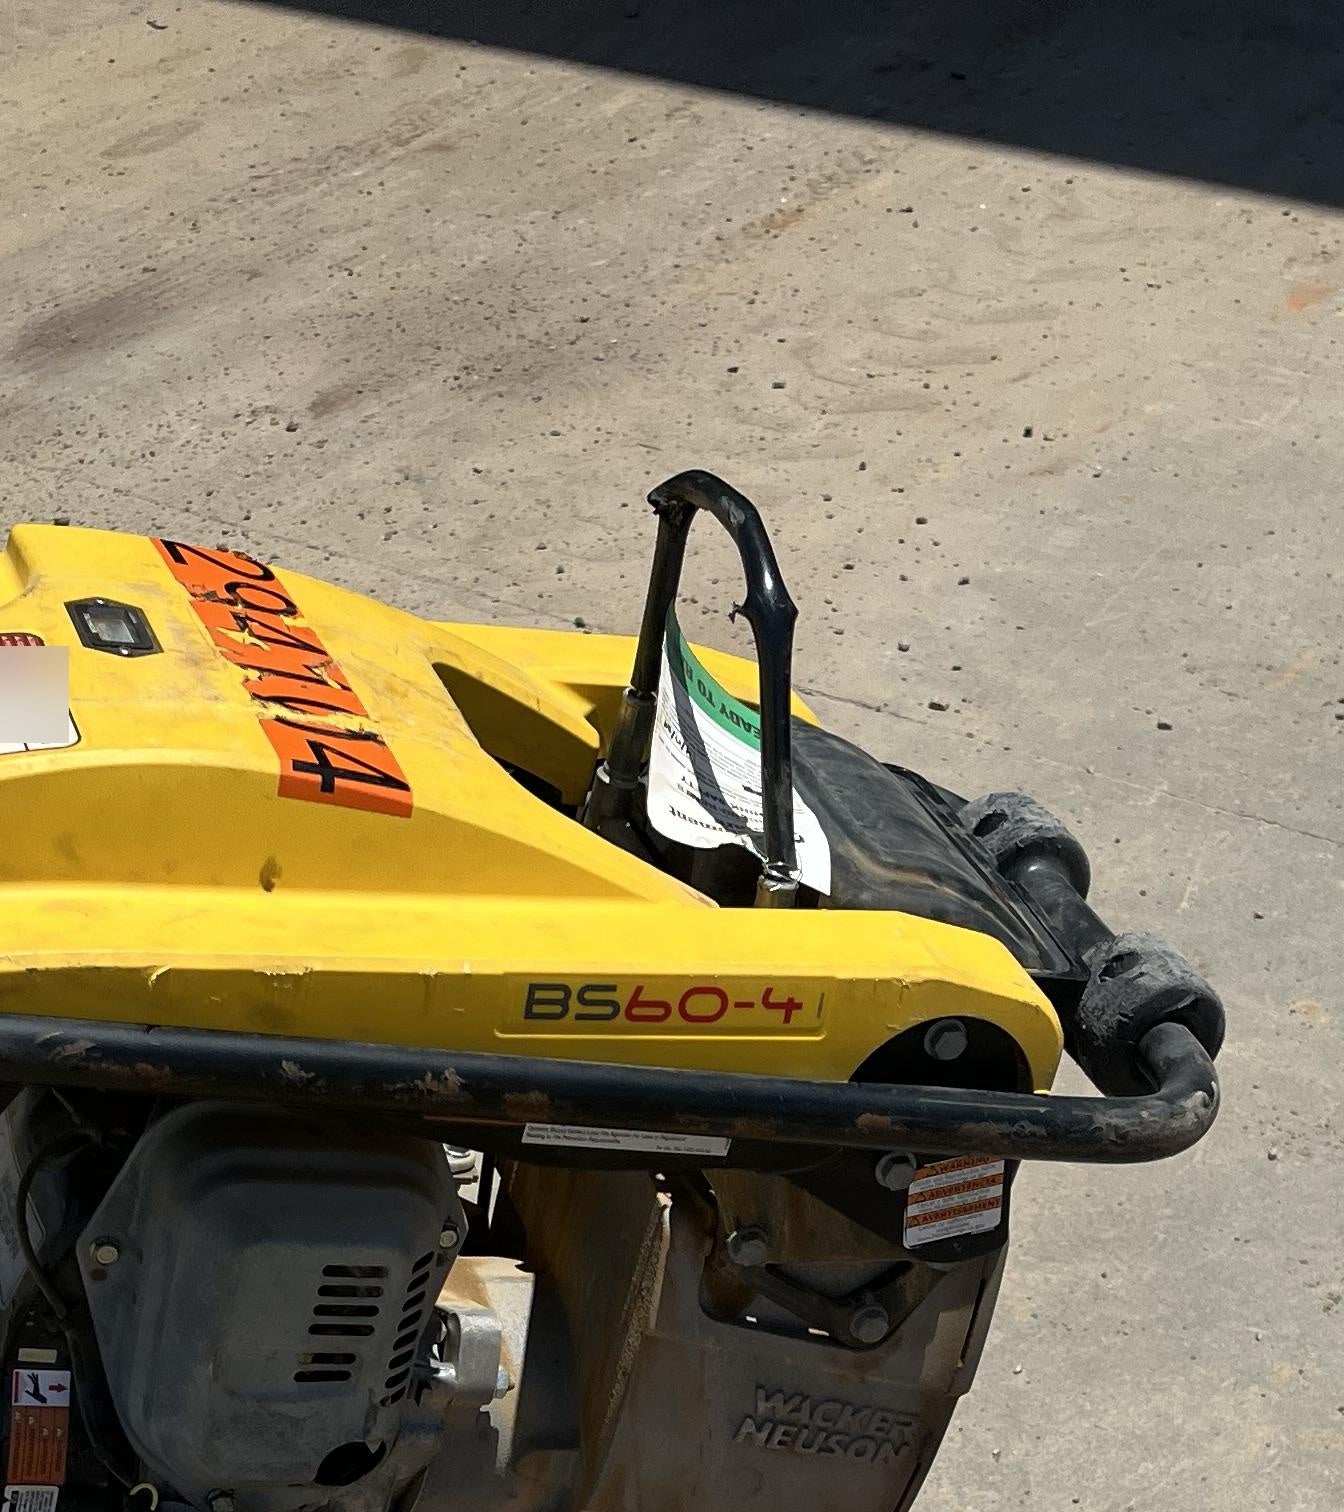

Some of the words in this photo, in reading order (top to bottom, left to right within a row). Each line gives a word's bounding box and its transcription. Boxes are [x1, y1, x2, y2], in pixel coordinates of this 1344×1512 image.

[696, 681, 716, 709] TO
[718, 702, 761, 739] EADY
[523, 982, 804, 1024] BS60-4
[755, 1383, 918, 1441] WACKER
[733, 1414, 909, 1463] NEUSON
